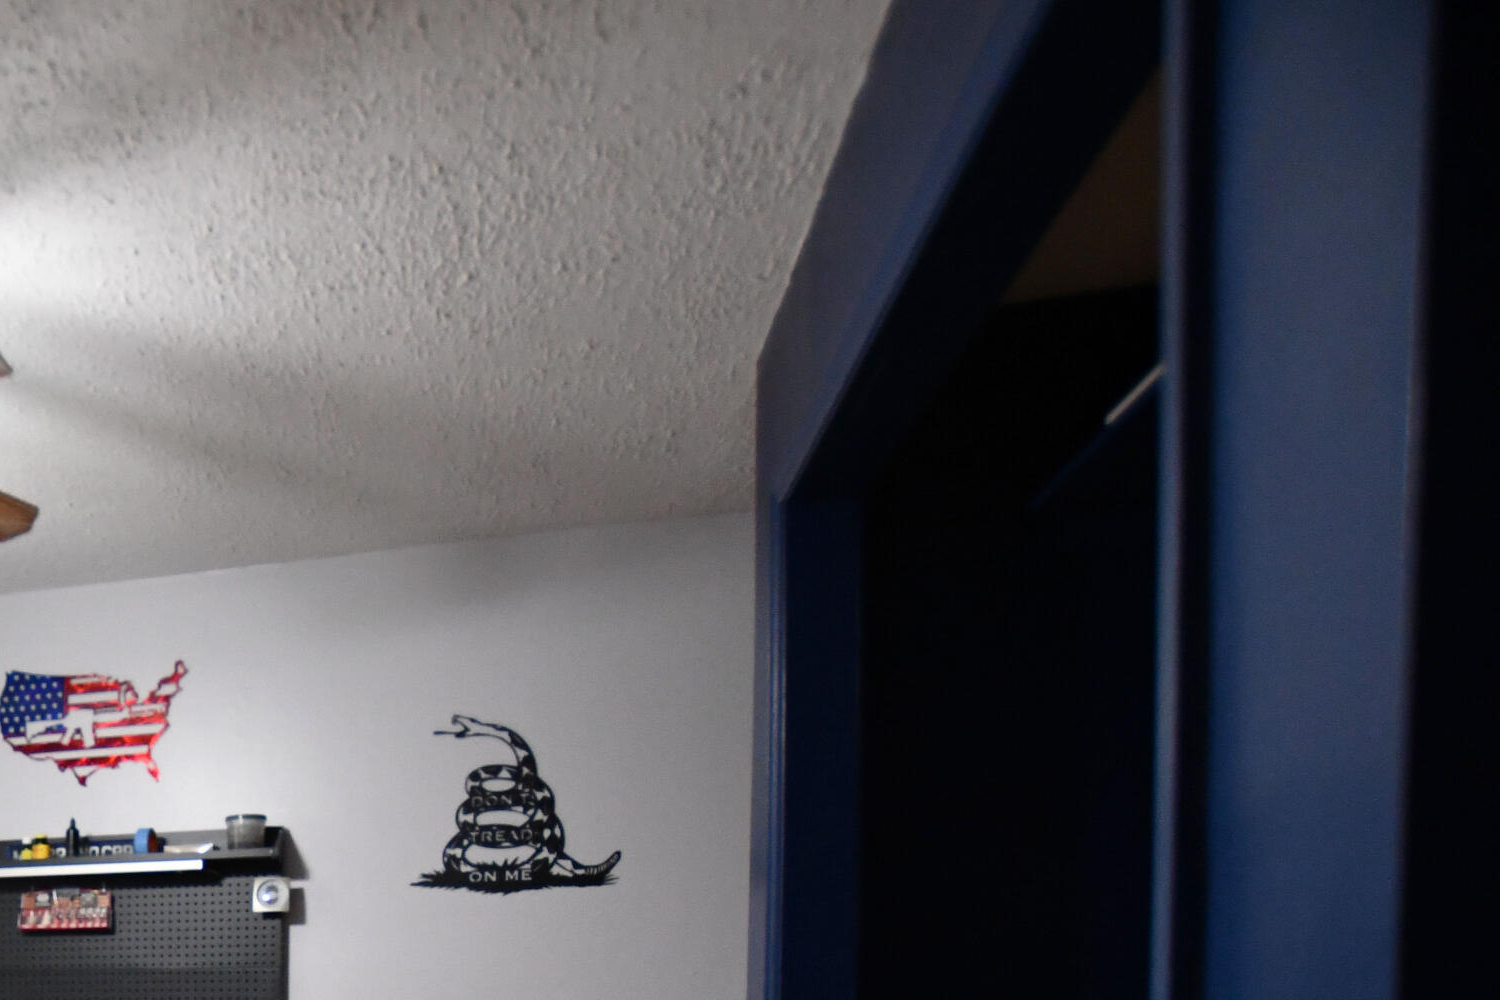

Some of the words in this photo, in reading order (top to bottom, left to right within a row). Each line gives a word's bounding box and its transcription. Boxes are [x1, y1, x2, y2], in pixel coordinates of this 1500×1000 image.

[470, 829, 533, 842] TREAD
[469, 870, 497, 883] ON
[505, 869, 532, 881] ME
